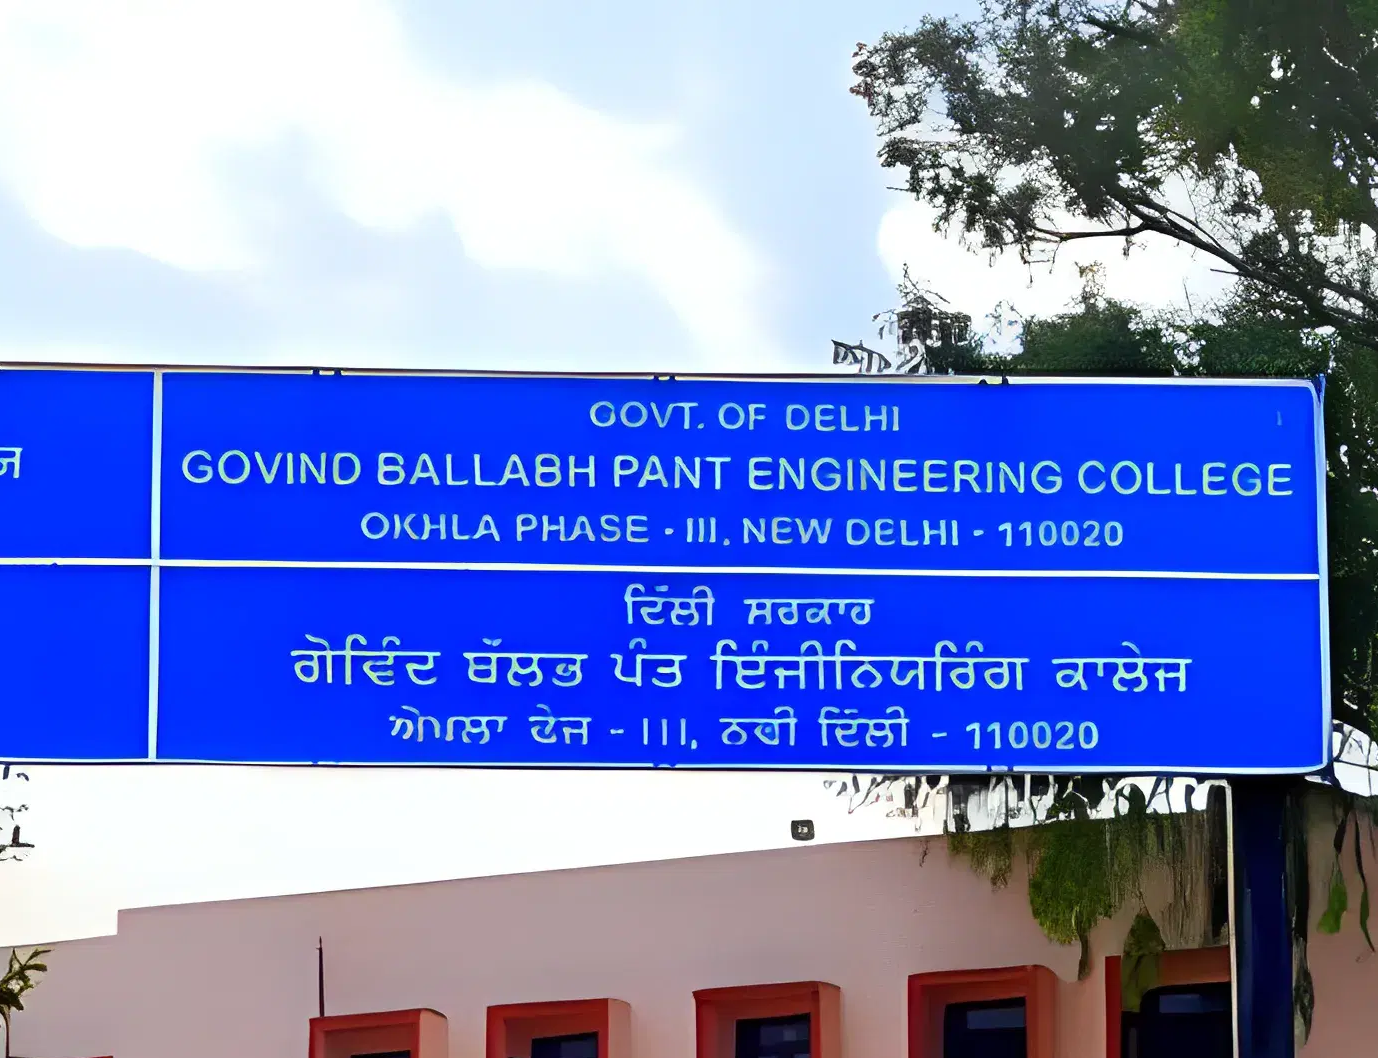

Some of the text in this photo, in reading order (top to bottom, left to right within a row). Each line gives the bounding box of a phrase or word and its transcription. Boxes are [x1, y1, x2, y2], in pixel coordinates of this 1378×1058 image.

[589, 400, 900, 432] GOVT. OF DELHI
[181, 449, 1294, 497] GOVIND BALLABH PANT ENGINEERING COLLEGE
[360, 511, 501, 542] OKHLA
[515, 513, 650, 543] PHASE
[742, 516, 833, 545] NEW
[845, 518, 959, 547] DELHI
[998, 520, 1124, 547] 110020
[609, 637, 688, 688] ਪੰਤ
[965, 720, 1099, 750] 110020
